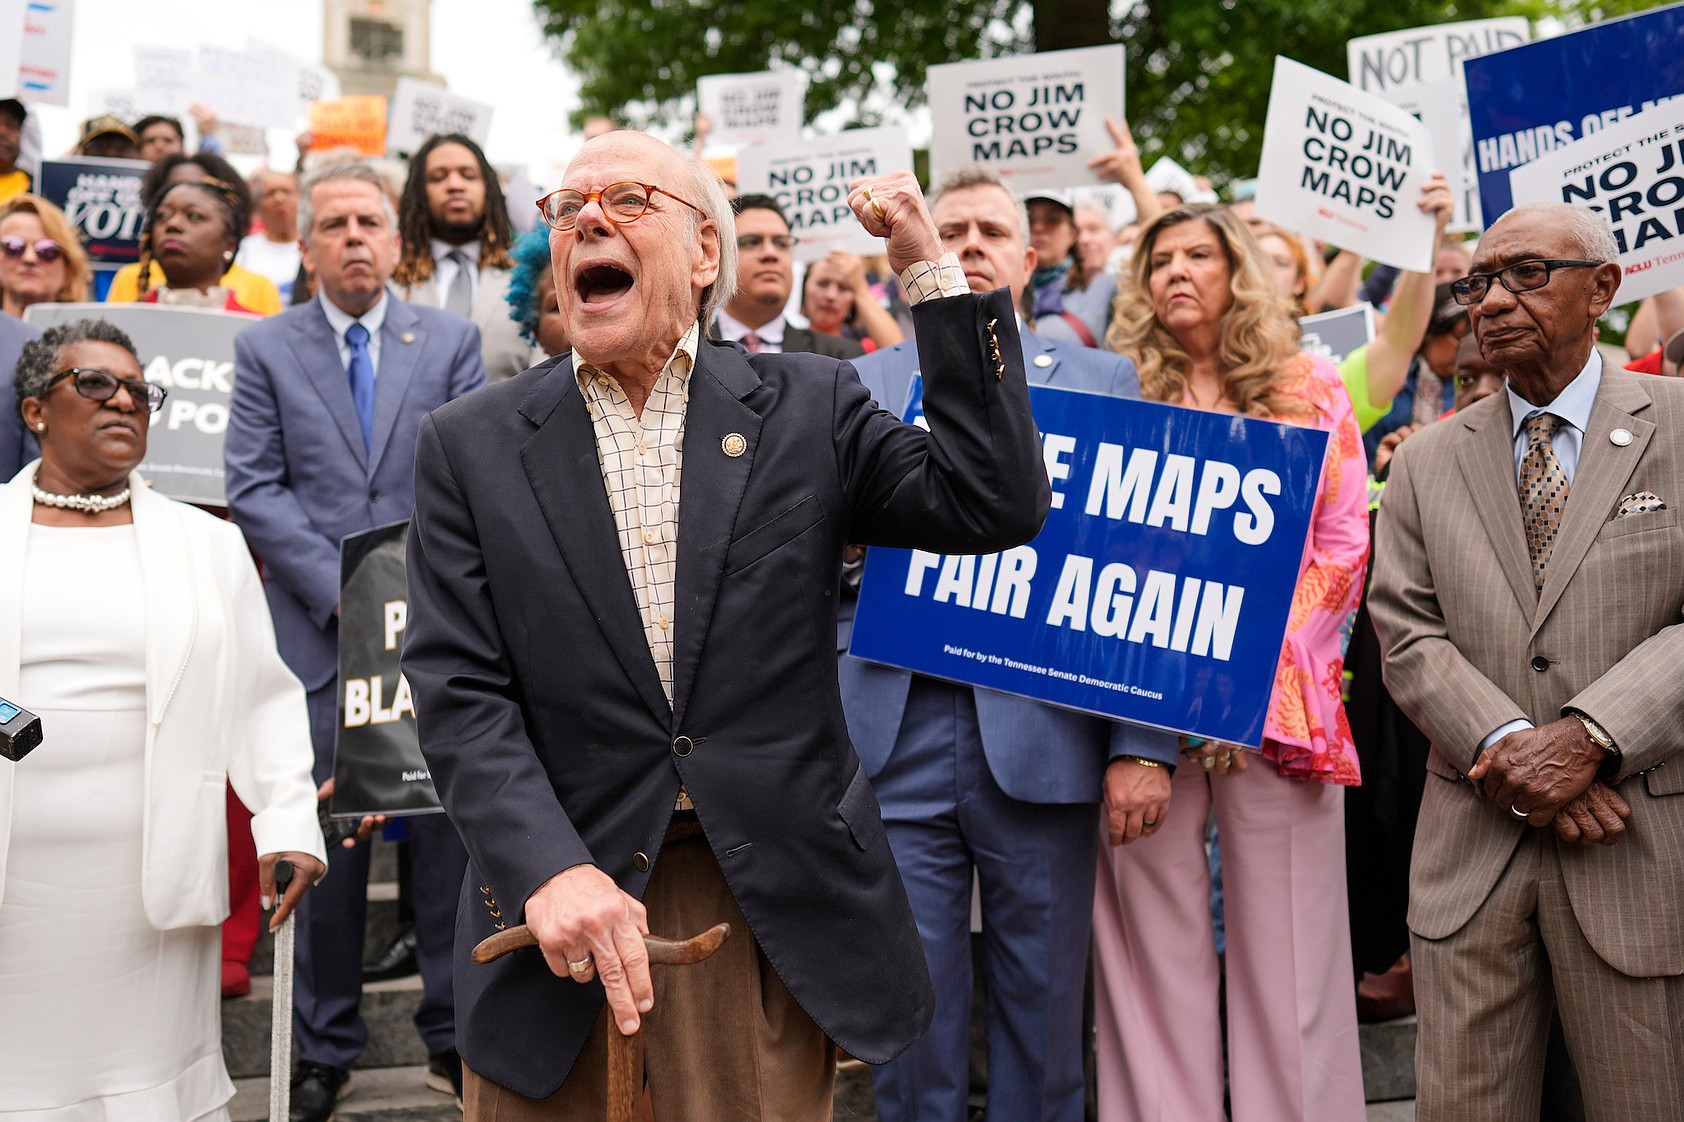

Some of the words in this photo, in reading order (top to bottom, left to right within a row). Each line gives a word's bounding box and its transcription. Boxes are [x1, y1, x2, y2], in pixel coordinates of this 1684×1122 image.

[1361, 37, 1435, 92] NOT
[965, 90, 1015, 113] NO
[1027, 83, 1084, 107] JIM
[967, 108, 1081, 137] CROW
[1305, 106, 1353, 142] NO
[1362, 129, 1412, 167] JIM
[973, 133, 1078, 161] MAPS
[1303, 137, 1407, 192] CROW
[1477, 119, 1575, 174] HANDS
[1564, 143, 1632, 177] PROTECT
[1638, 130, 1670, 149] THE
[769, 165, 814, 189] NO
[827, 157, 877, 181] JIM
[1301, 165, 1396, 219] MAPS
[1562, 161, 1638, 204] NO
[776, 183, 851, 209] CRO
[790, 206, 852, 230] MAP
[64, 202, 148, 240] VOT
[143, 355, 235, 393] ACK
[168, 399, 231, 434] PO
[1085, 441, 1282, 547] MAPS
[904, 545, 1038, 619] FAIR
[1046, 554, 1245, 661] AGAIN
[944, 644, 962, 656] Paid
[963, 648, 976, 660] for
[976, 650, 988, 663] by
[988, 654, 1003, 666] the
[1004, 657, 1047, 676] Tennessee
[1048, 667, 1078, 683] Senate
[1079, 674, 1129, 693] Democratic
[1130, 686, 1163, 701] Caucus
[344, 671, 417, 728] BLA
